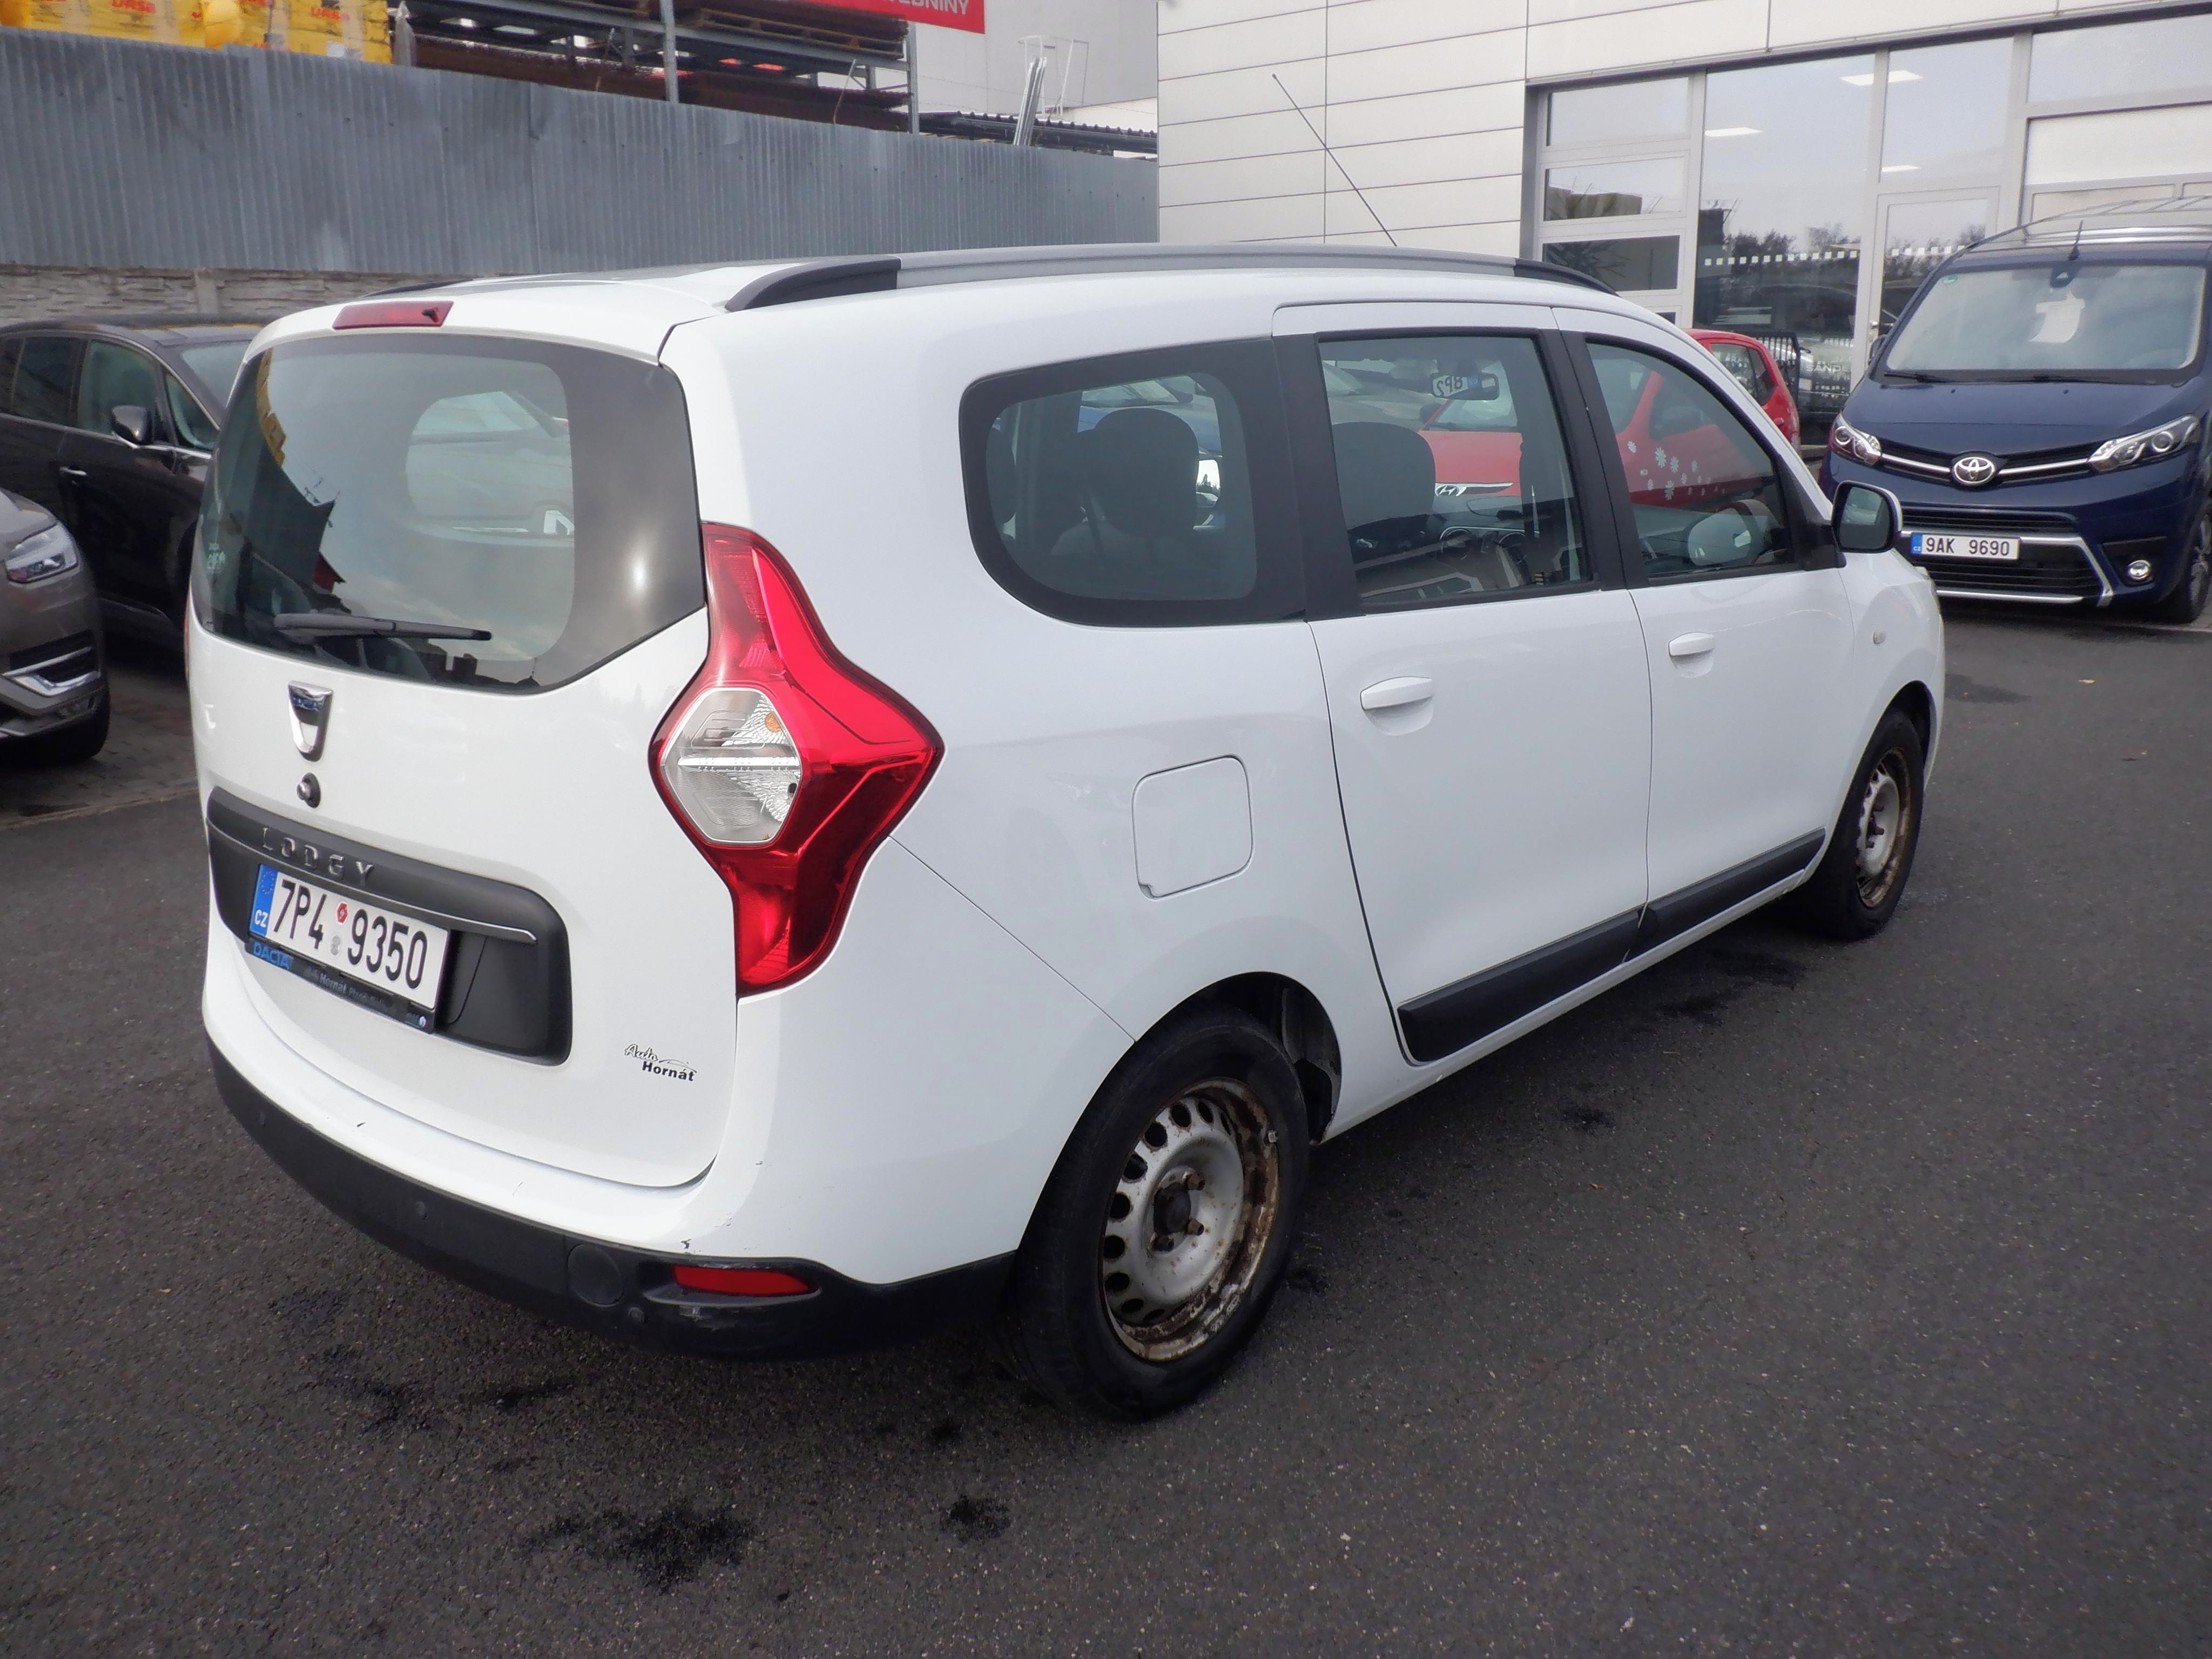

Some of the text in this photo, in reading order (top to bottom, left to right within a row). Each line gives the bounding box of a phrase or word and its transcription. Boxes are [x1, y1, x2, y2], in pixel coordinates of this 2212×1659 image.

[1926, 537, 2009, 556] 9AK 9690
[262, 827, 374, 887] LODGY
[255, 909, 269, 928] CZ
[273, 879, 428, 989] 7P4 9350
[253, 942, 293, 969] DACIA
[624, 1043, 659, 1062] Auto
[642, 1061, 695, 1082] Hornát
